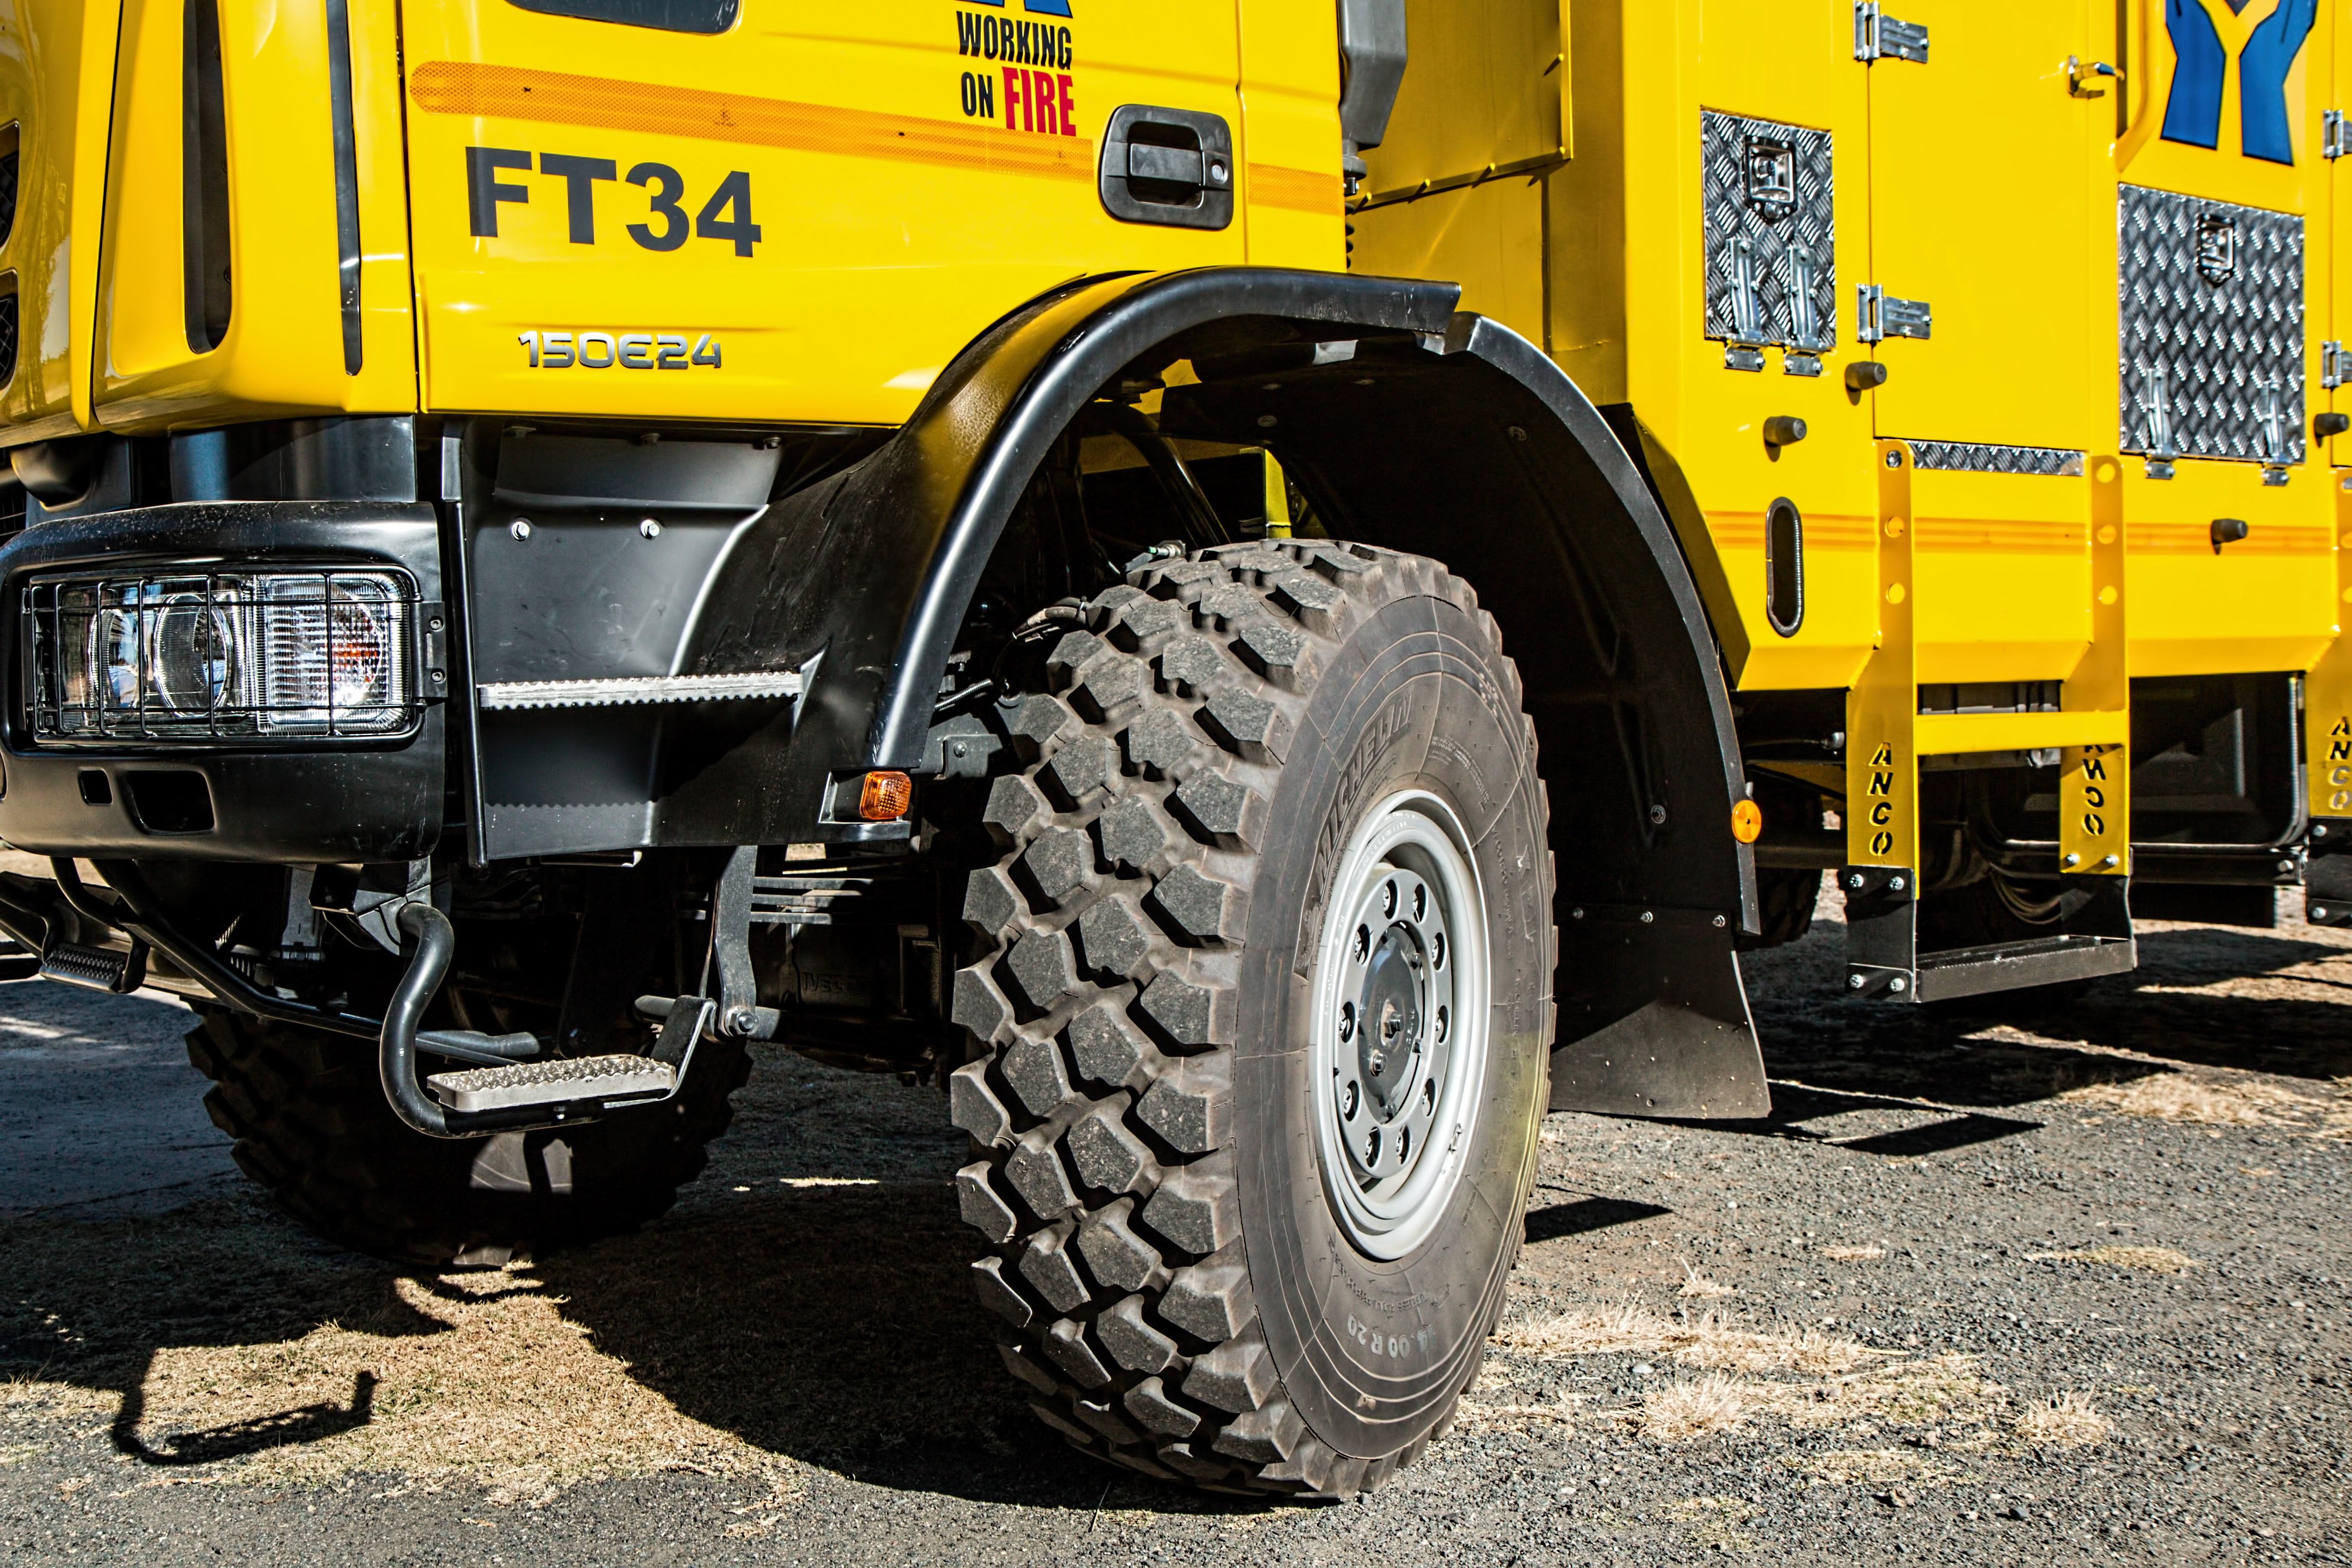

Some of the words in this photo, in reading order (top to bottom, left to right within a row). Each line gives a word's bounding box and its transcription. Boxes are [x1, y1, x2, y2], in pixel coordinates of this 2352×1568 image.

[956, 10, 1072, 70] WORKING
[961, 71, 994, 119] ON
[1002, 66, 1076, 137] FIRE
[465, 146, 762, 258] FT34
[518, 331, 722, 369] 150E24
[1315, 693, 1413, 894] MICHELIN
[1867, 741, 1894, 856] ANCO
[2324, 715, 2352, 811] ANCO
